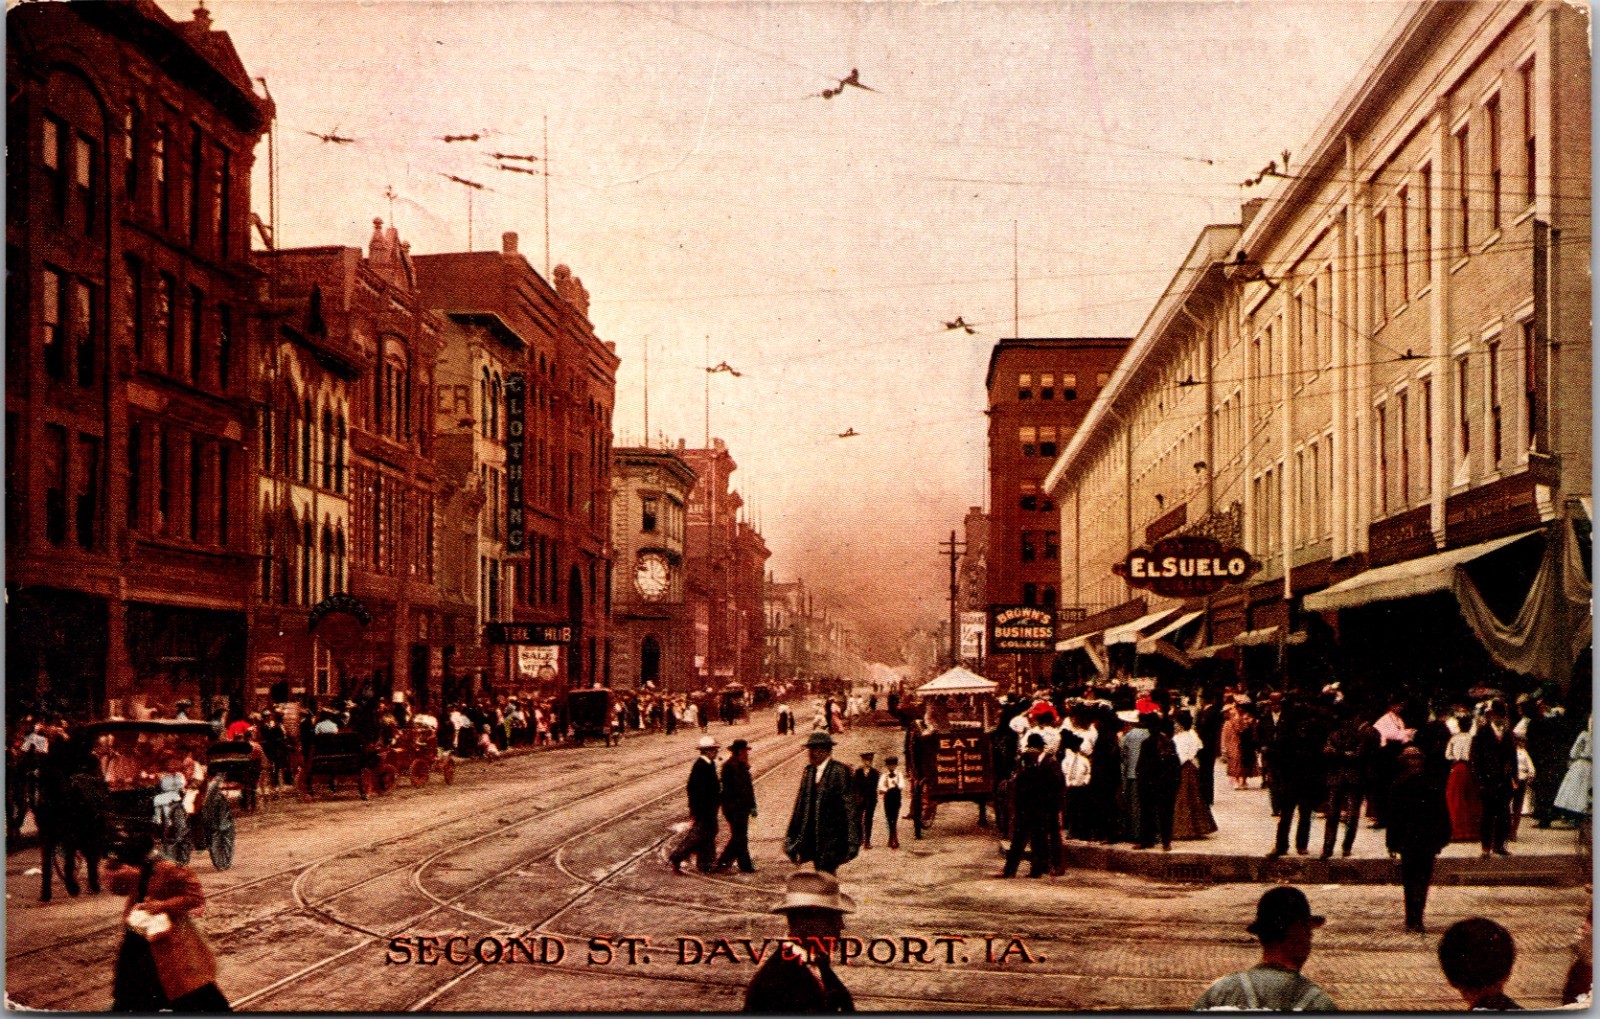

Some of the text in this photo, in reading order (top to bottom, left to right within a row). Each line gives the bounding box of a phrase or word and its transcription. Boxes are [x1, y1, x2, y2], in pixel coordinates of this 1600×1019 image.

[508, 376, 524, 546] CLOTHING
[997, 607, 1052, 624] BROWN'S
[994, 626, 1054, 638] BUSINESS
[1000, 640, 1047, 649] COLLEGE
[939, 737, 979, 749] EAT
